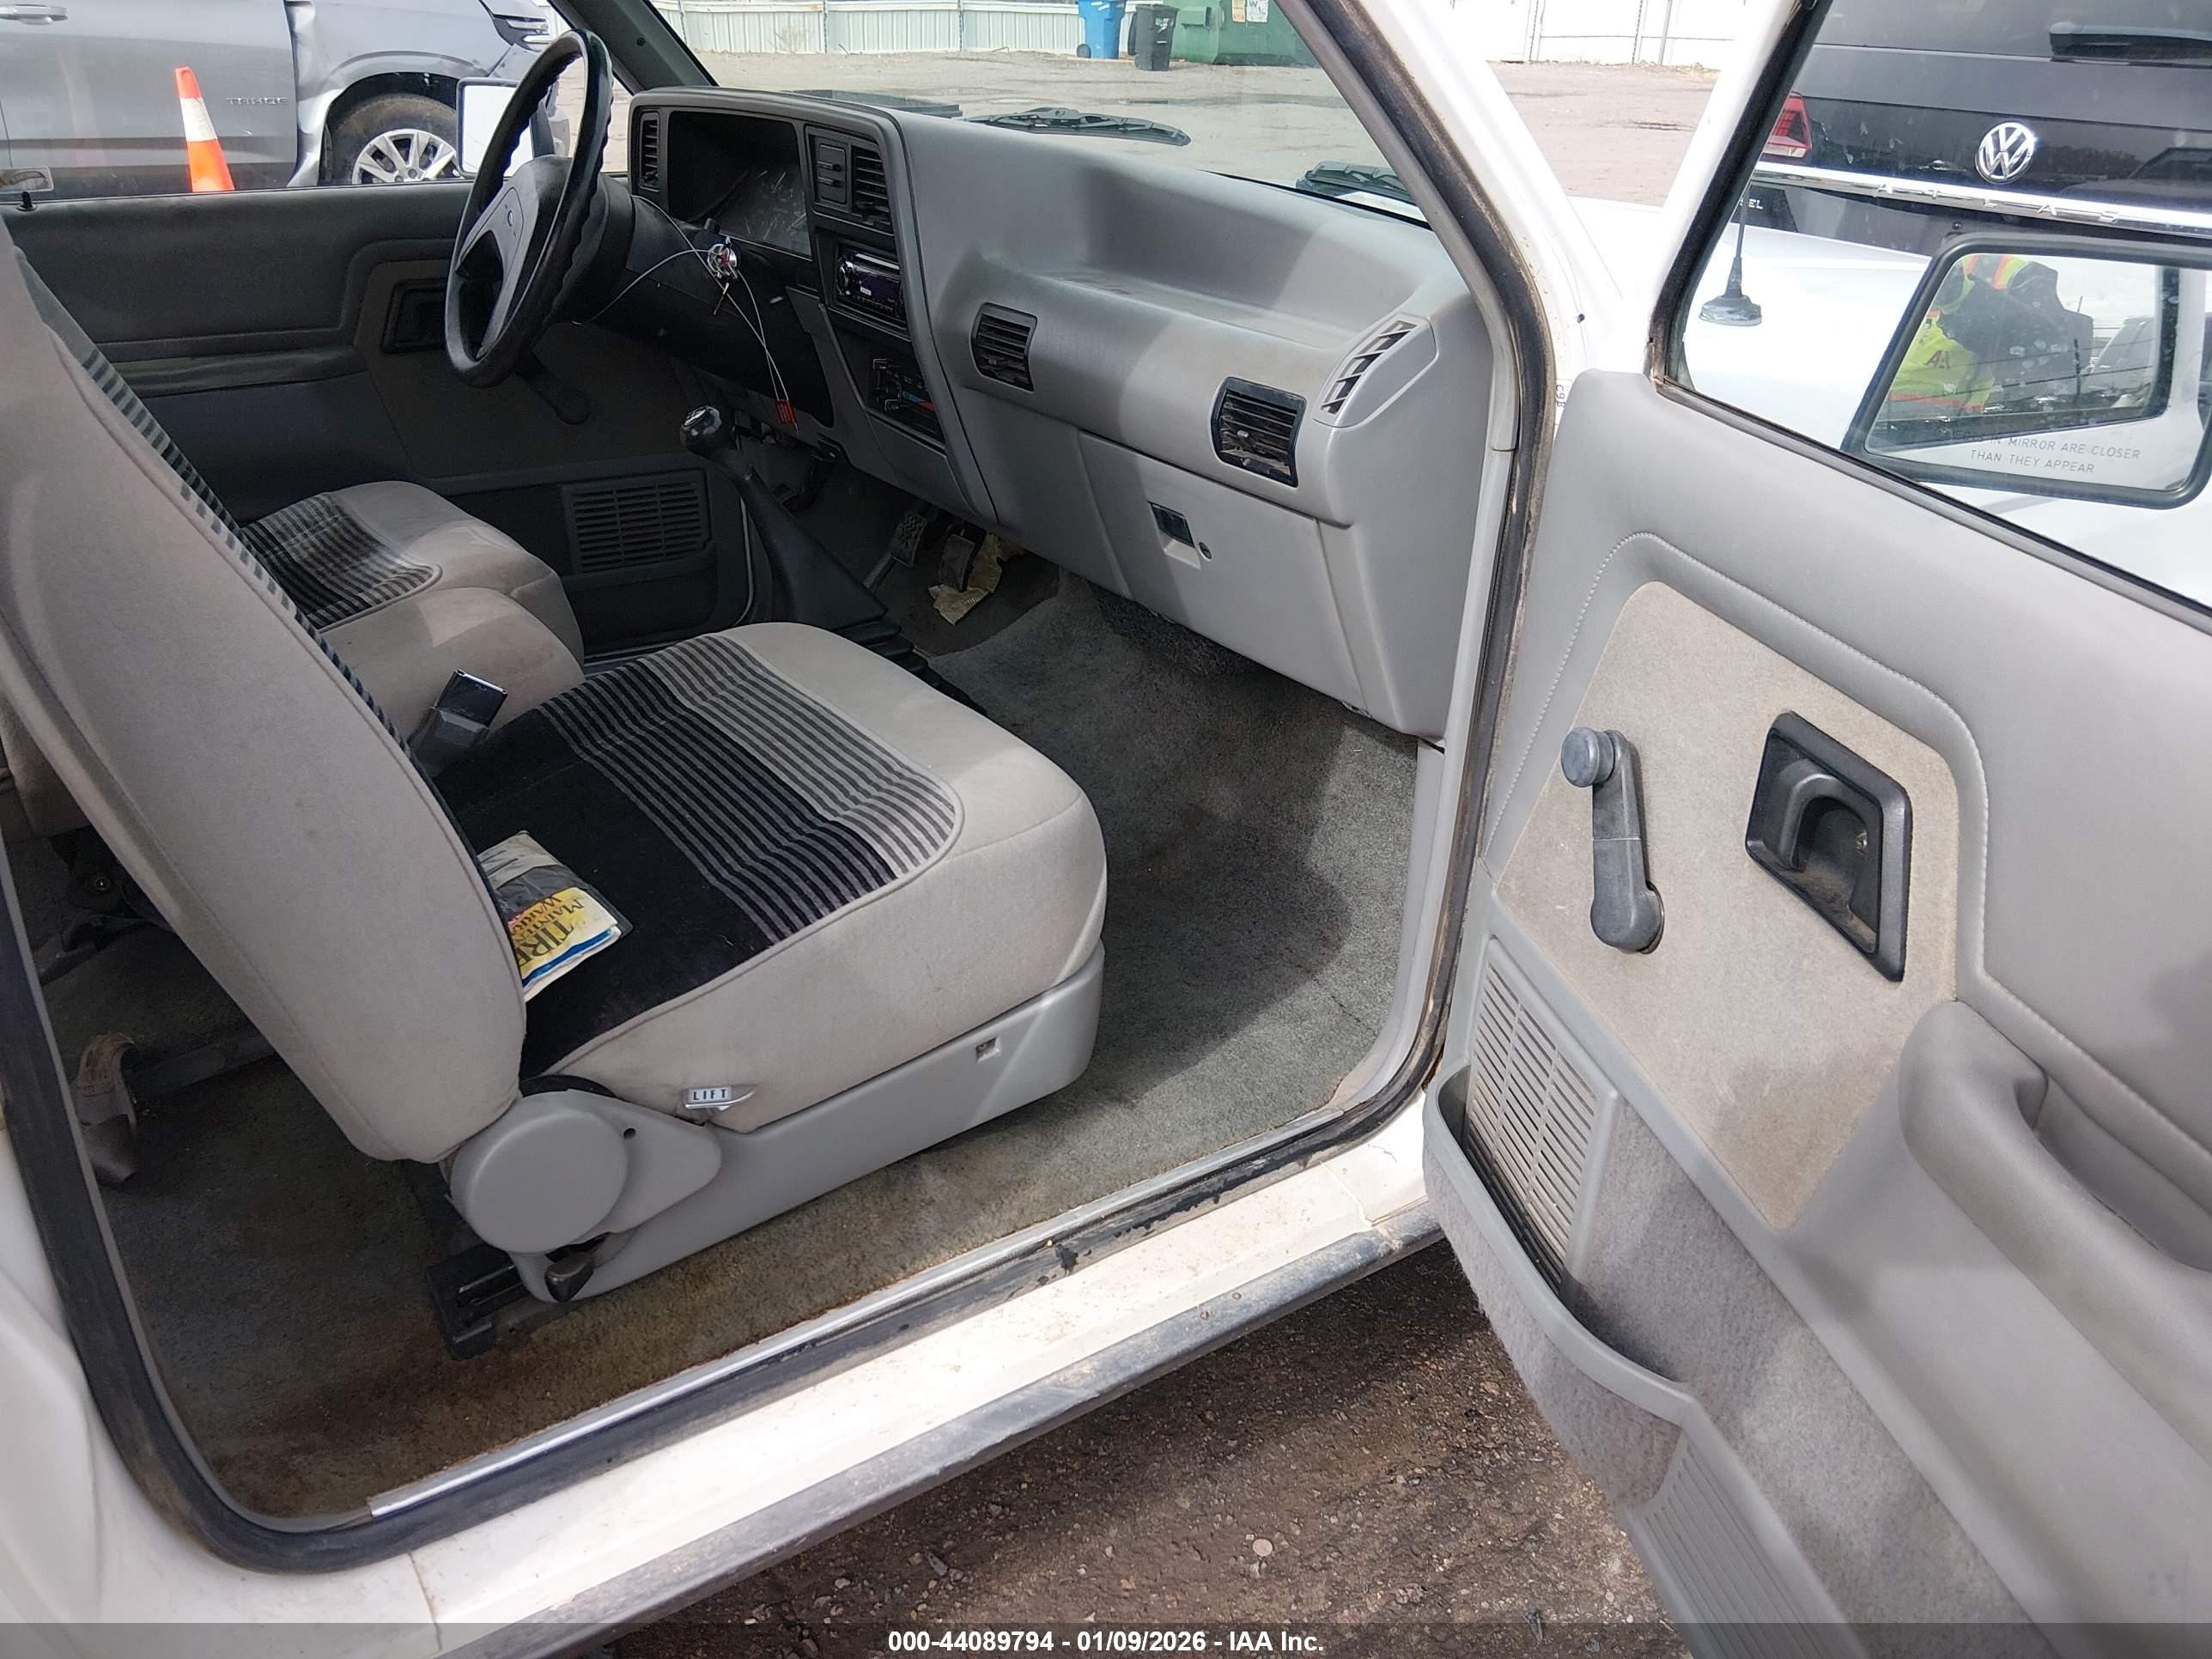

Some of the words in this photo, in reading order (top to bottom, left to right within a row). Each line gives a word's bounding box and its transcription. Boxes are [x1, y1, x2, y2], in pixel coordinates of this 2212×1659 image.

[2008, 437, 2056, 451] MIRROR
[2061, 443, 2087, 454] ARE
[2091, 446, 2142, 459] CLOSER
[1971, 450, 2002, 462] THAN
[2008, 454, 2040, 467] THEY
[2045, 459, 2095, 473] APPEAR
[693, 1089, 726, 1101] LIFT
